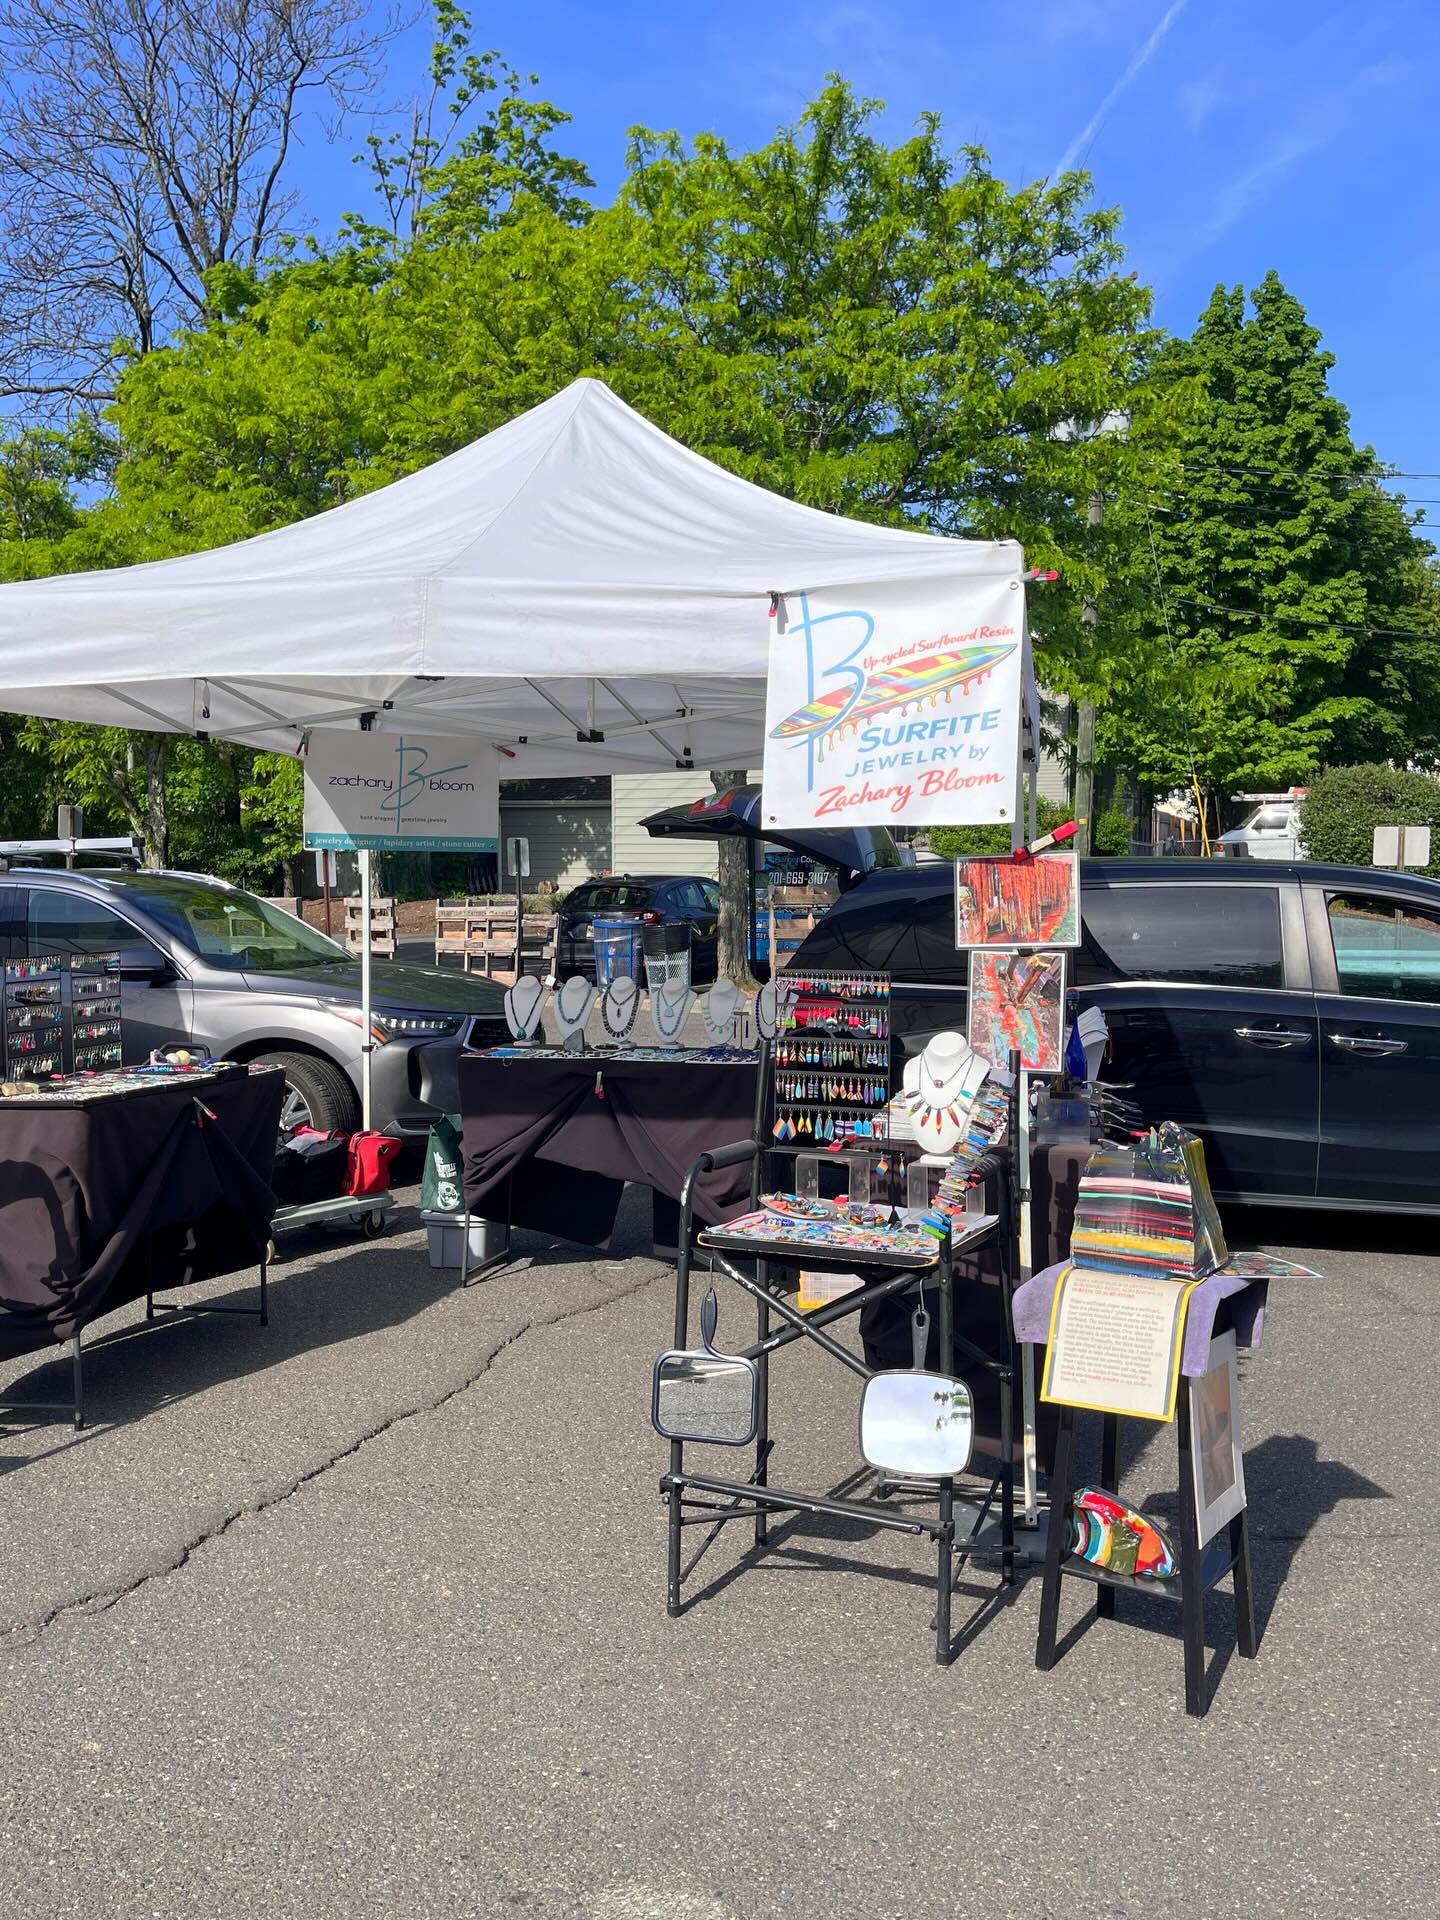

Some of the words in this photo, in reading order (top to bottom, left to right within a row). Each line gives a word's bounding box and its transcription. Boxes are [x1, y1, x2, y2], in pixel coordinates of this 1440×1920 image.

[863, 643, 916, 670] Up-cycled
[918, 628, 977, 652] Surfboard
[980, 625, 1016, 639] Resin
[857, 708, 1001, 753] SURFITE
[845, 743, 965, 778] JEWELRY
[968, 746, 990, 760] by
[328, 775, 393, 791] zachary
[429, 779, 475, 792] bloom
[814, 781, 915, 818] Zachary
[917, 767, 1005, 796] Bloom
[315, 837, 342, 846] jewelry
[344, 837, 376, 847] designer
[384, 839, 414, 848] lapidary
[442, 840, 463, 848] stone
[463, 840, 486, 848] cutter
[768, 871, 829, 885] 201-669-3107
